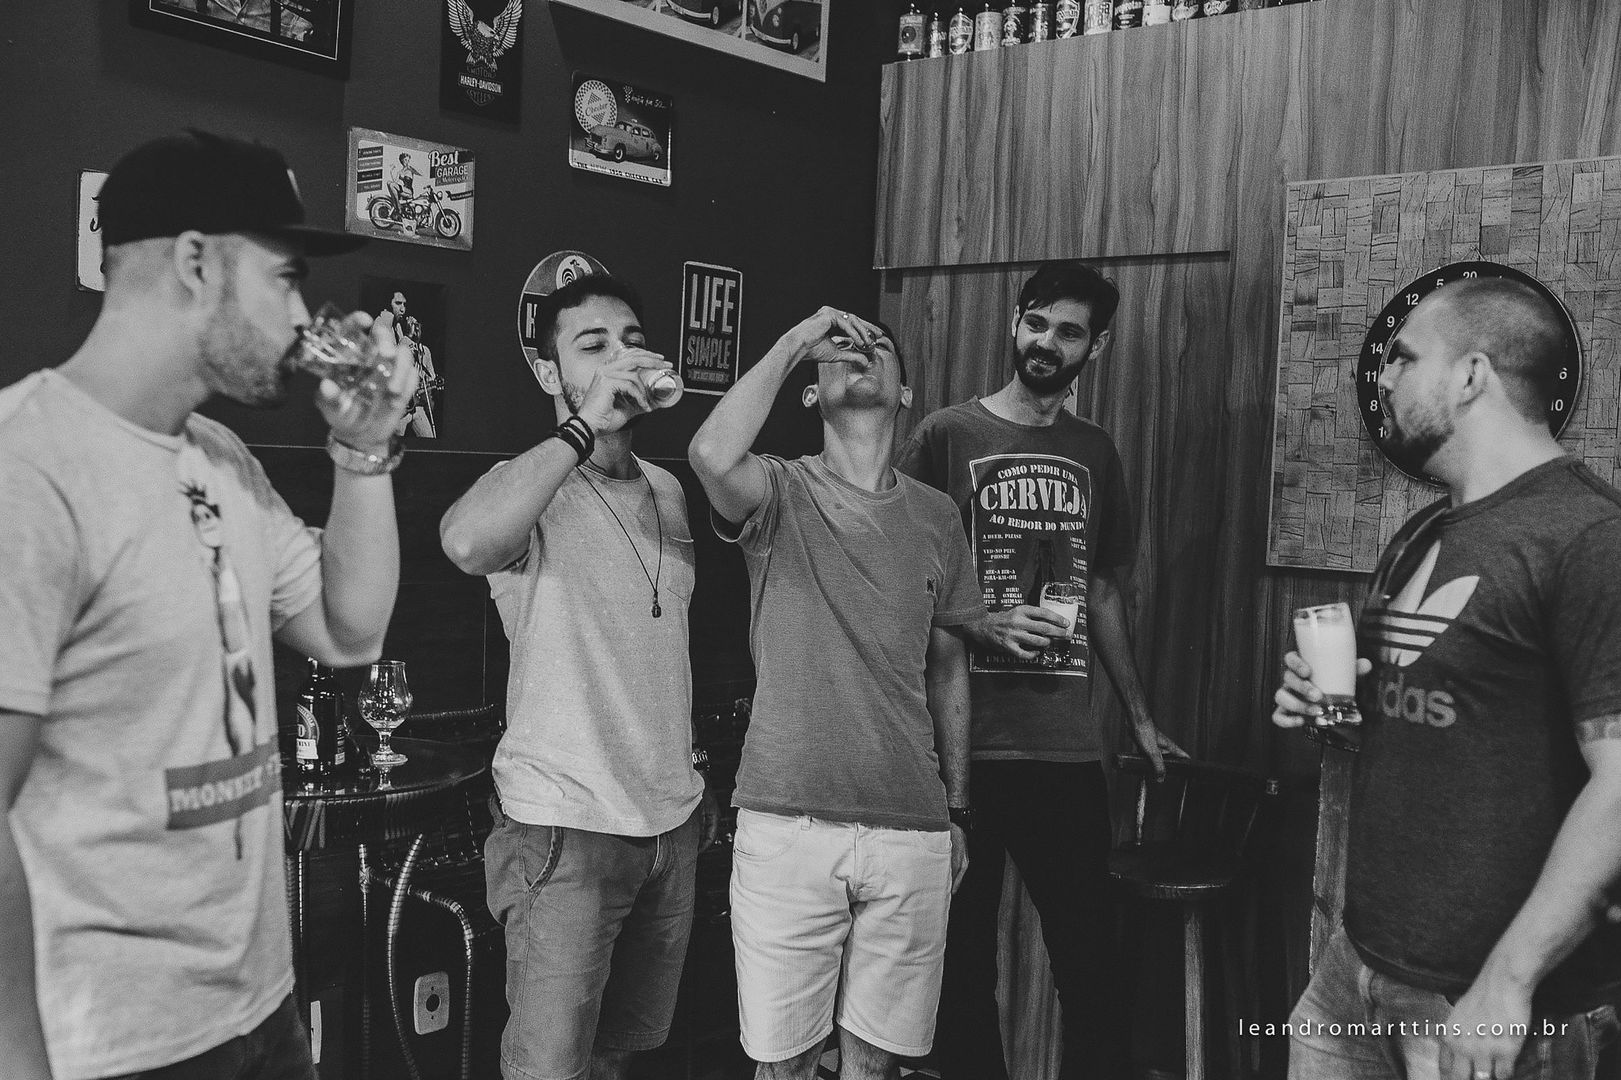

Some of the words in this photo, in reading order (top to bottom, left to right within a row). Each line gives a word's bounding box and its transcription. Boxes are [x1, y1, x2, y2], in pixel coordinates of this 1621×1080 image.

[460, 75, 502, 93] HARLEY-DAVIDSON
[428, 150, 459, 167] Best
[436, 165, 469, 178] GARAGE
[1436, 279, 1445, 288] 5
[689, 273, 737, 333] LIFE
[1405, 293, 1419, 305] 12
[1387, 315, 1395, 328] 9
[686, 335, 732, 369] SIMPLE
[1370, 343, 1383, 354] 14
[1365, 370, 1377, 382] 11
[1370, 399, 1378, 411] 8
[1551, 399, 1563, 411] 10
[1378, 426, 1387, 438] 1
[997, 465, 1028, 480] COMO
[1030, 464, 1060, 477] PEDIR
[1062, 469, 1079, 486] UMA
[980, 478, 1087, 520] CERVEJA
[989, 513, 1005, 525] AO
[1007, 517, 1043, 530] REDOR
[1045, 521, 1057, 531] DO
